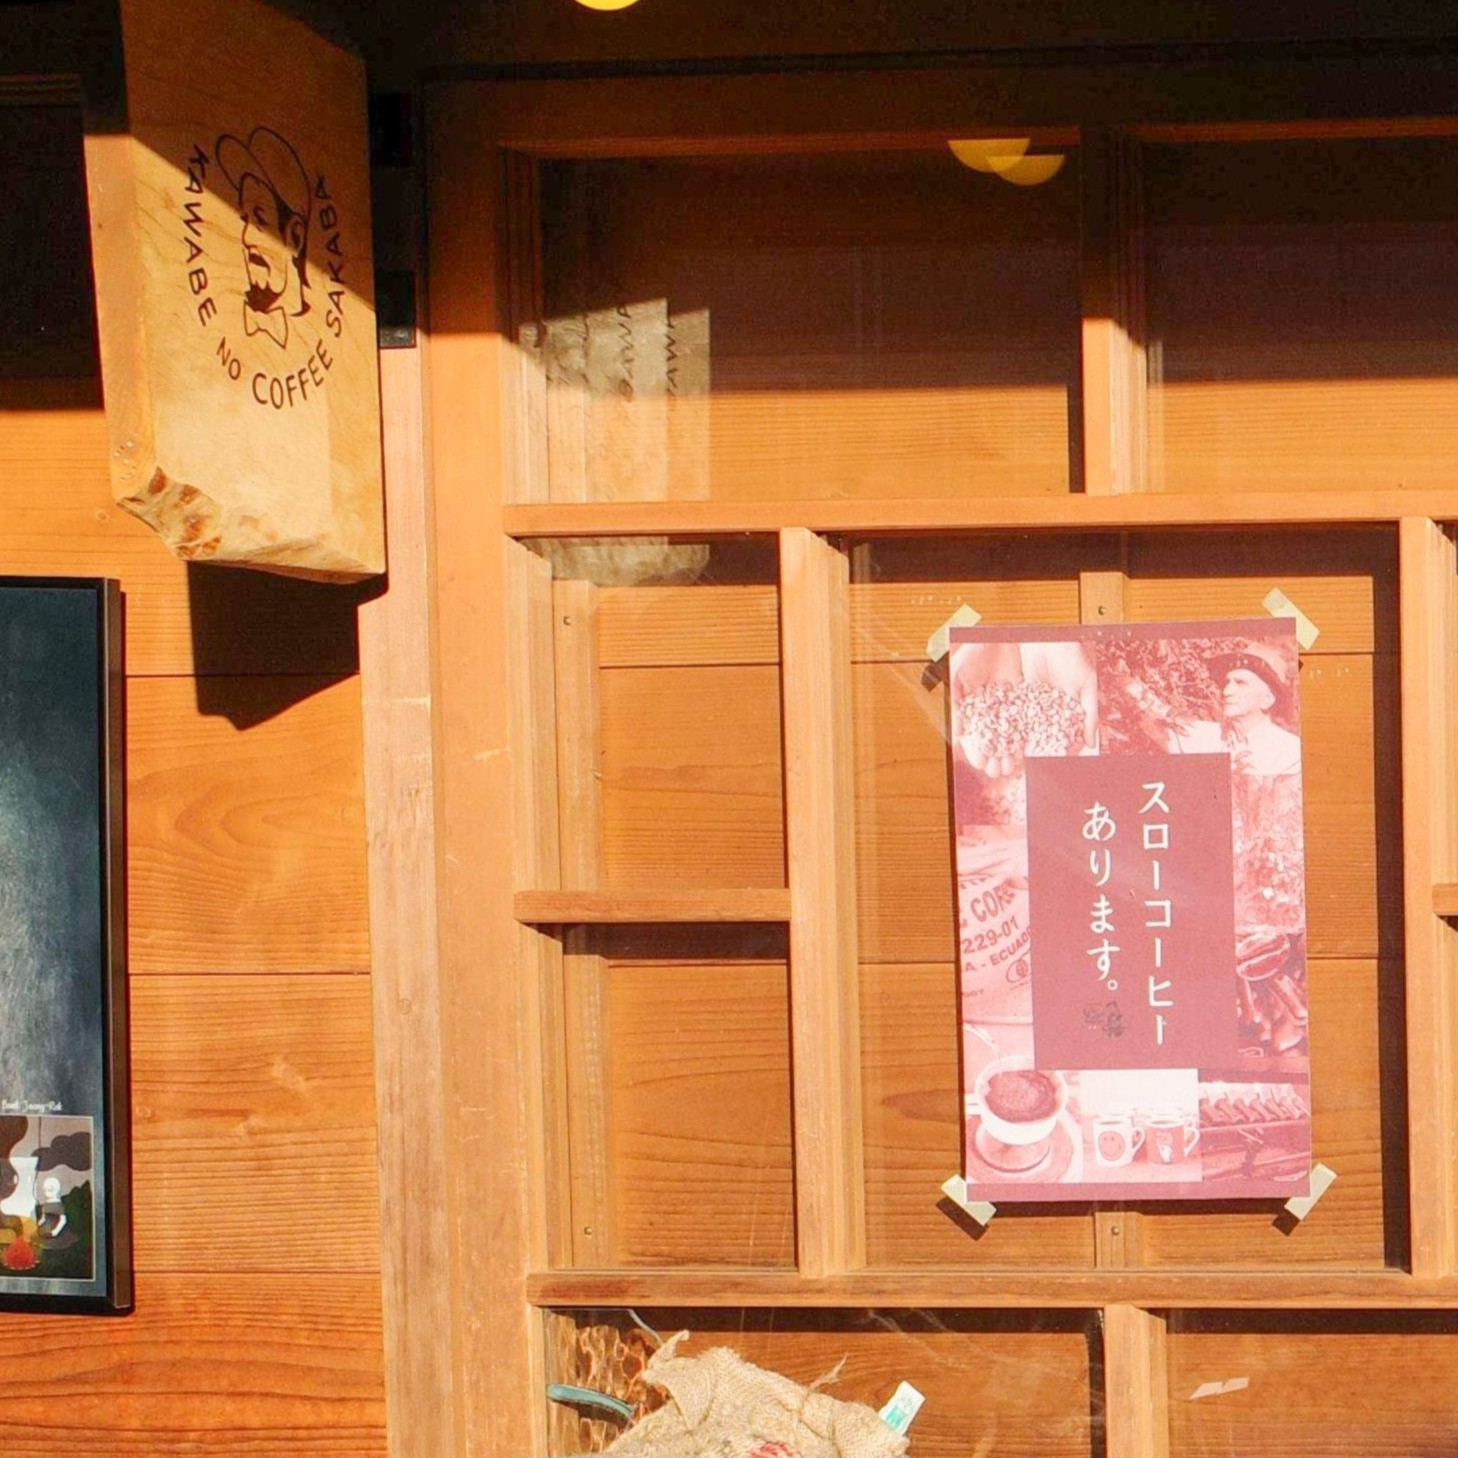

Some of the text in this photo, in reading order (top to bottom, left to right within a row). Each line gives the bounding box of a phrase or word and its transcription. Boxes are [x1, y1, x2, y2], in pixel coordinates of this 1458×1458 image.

[183, 144, 346, 410] KAWABE NO COFFEE SAKABA
[1080, 801, 1121, 992] あります。
[1137, 781, 1176, 1047] スローコーヒー
